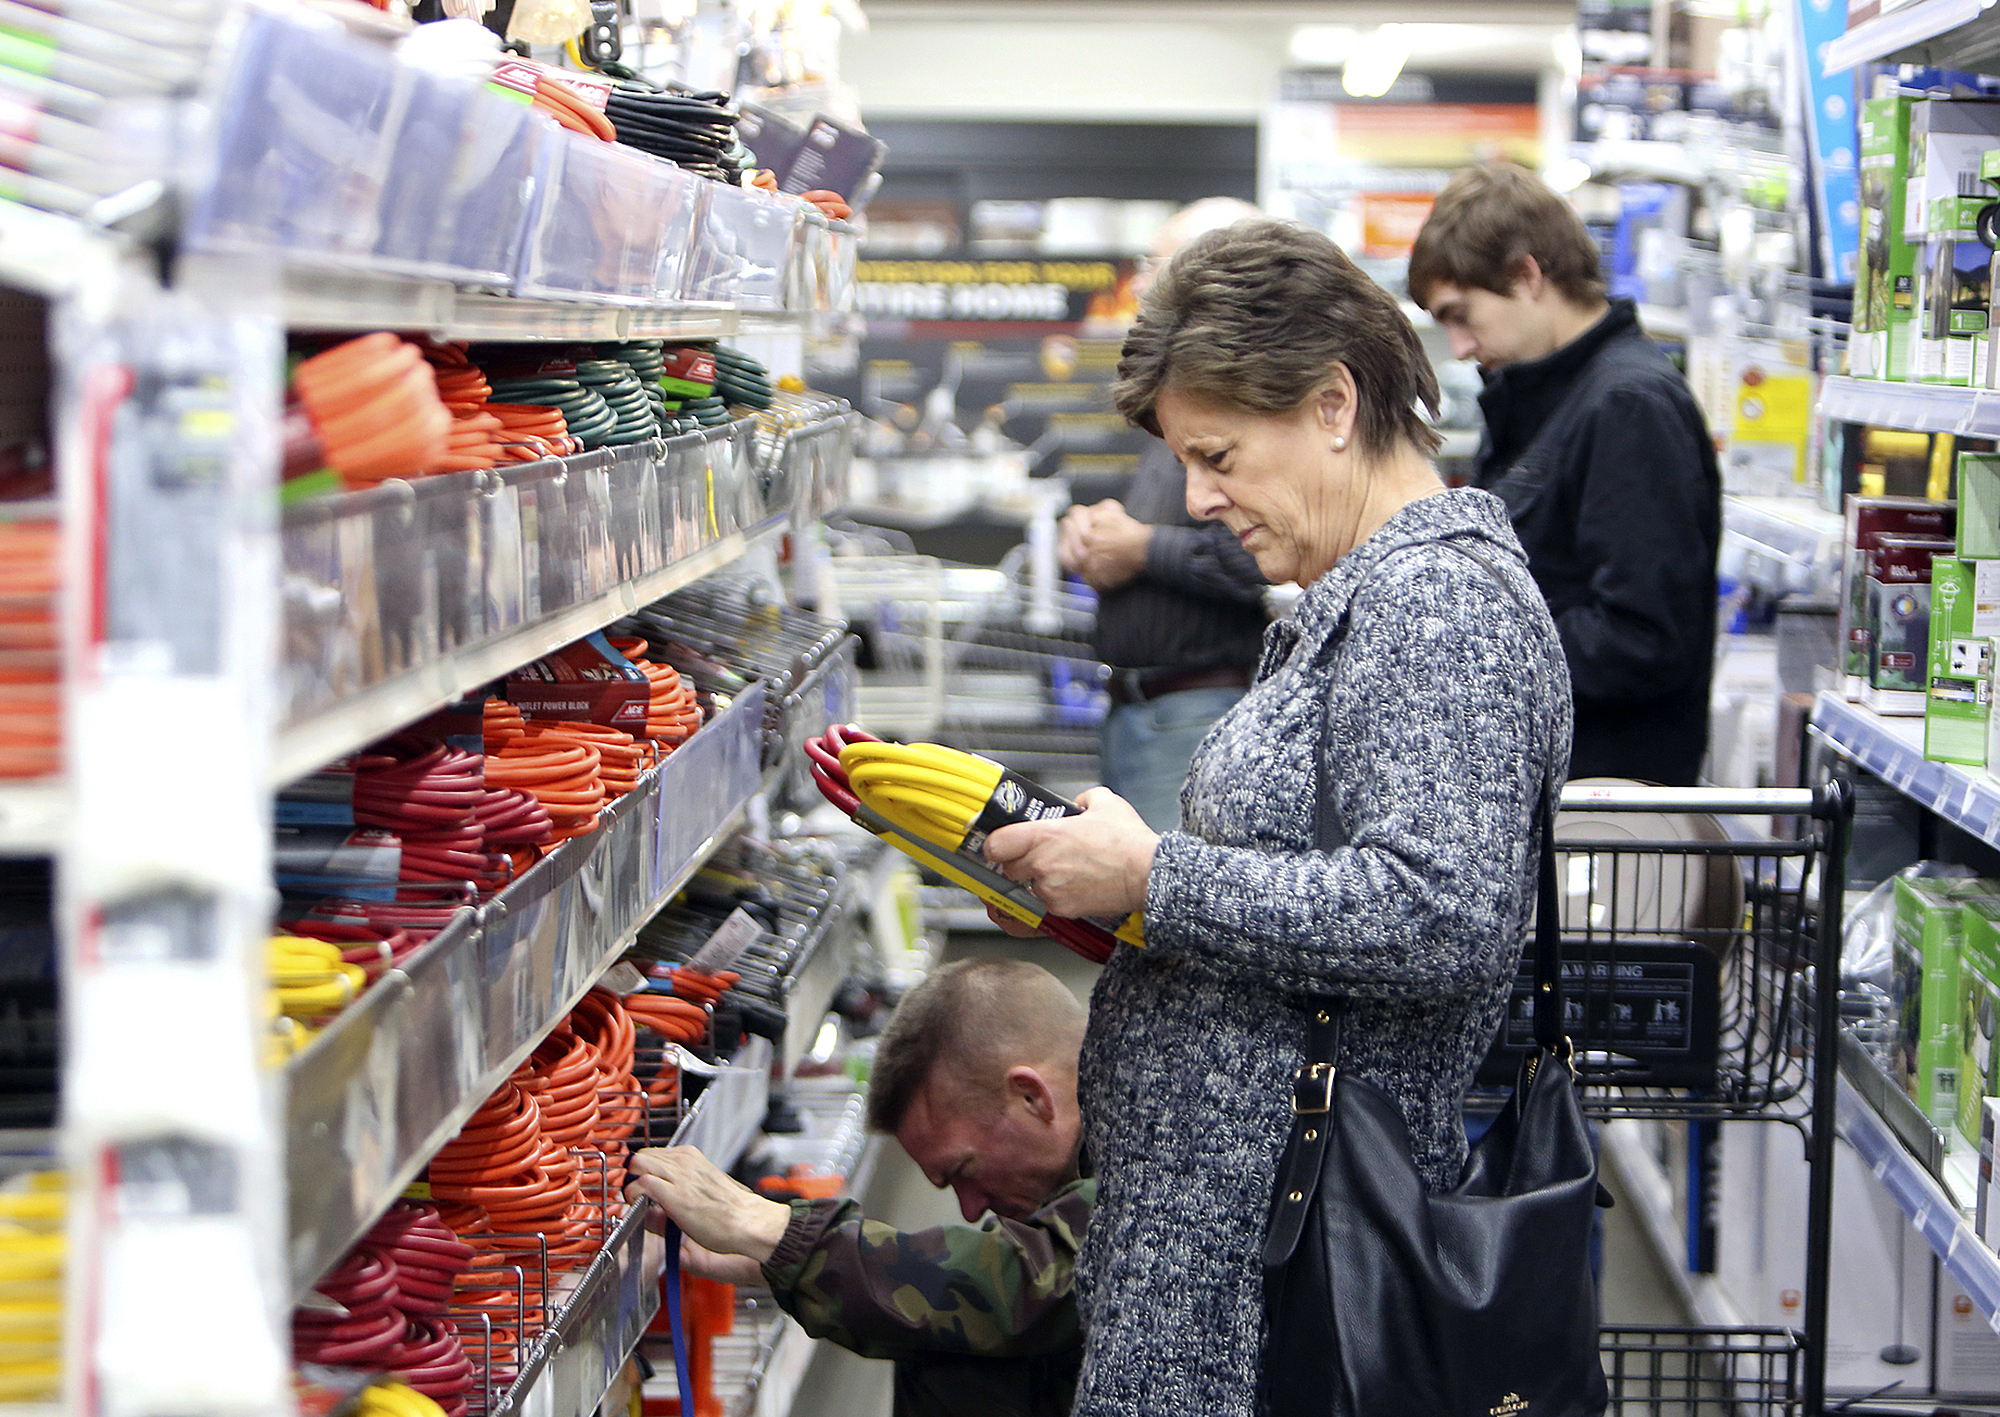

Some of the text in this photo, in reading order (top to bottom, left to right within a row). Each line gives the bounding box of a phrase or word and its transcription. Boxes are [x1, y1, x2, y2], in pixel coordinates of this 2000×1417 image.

[857, 281, 1070, 321] TIRE HOME
[517, 701, 590, 711] OUTLET POWER BLOCK
[624, 705, 644, 715] ACE
[1489, 1400, 1529, 1416] COACH
